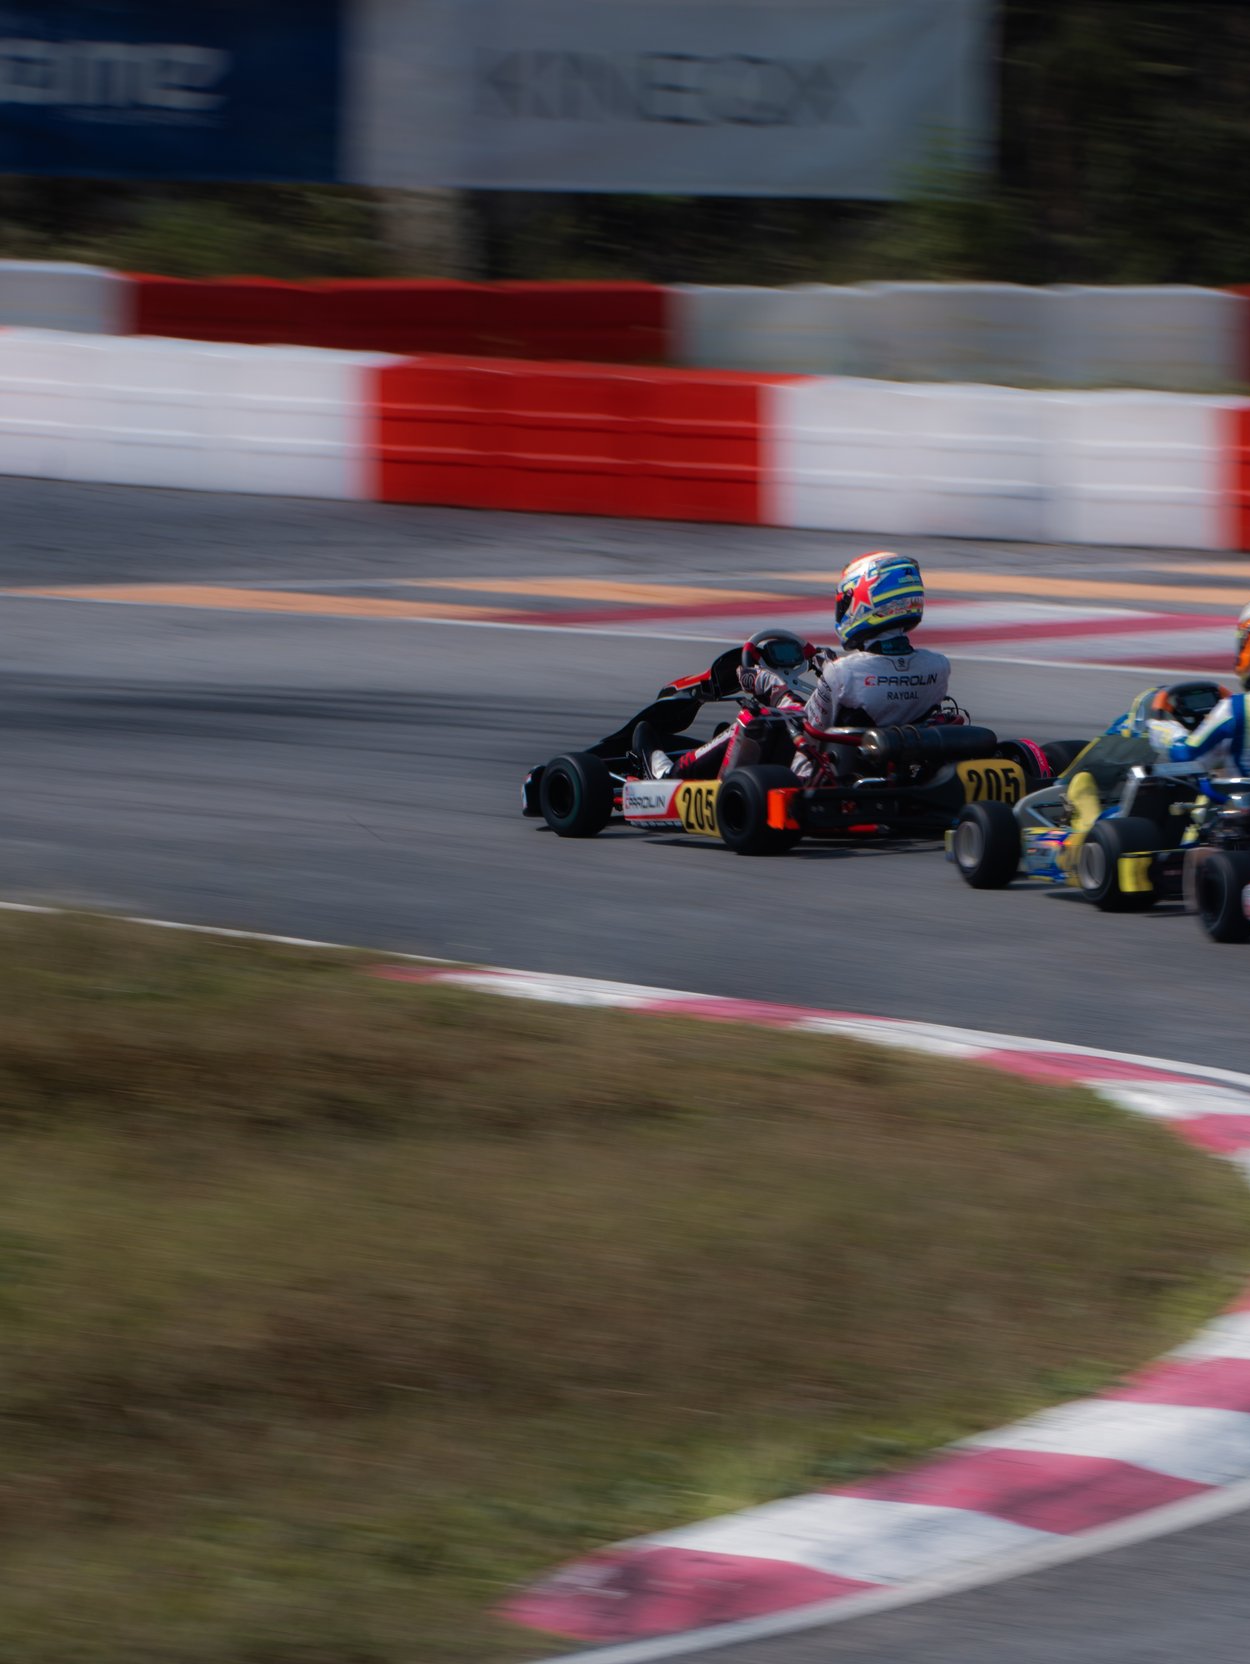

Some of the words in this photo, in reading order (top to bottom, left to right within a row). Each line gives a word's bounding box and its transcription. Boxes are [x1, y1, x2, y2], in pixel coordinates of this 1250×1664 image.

[877, 673, 938, 686] PAROLIN
[967, 767, 1021, 805] 205
[682, 787, 715, 831] 205
